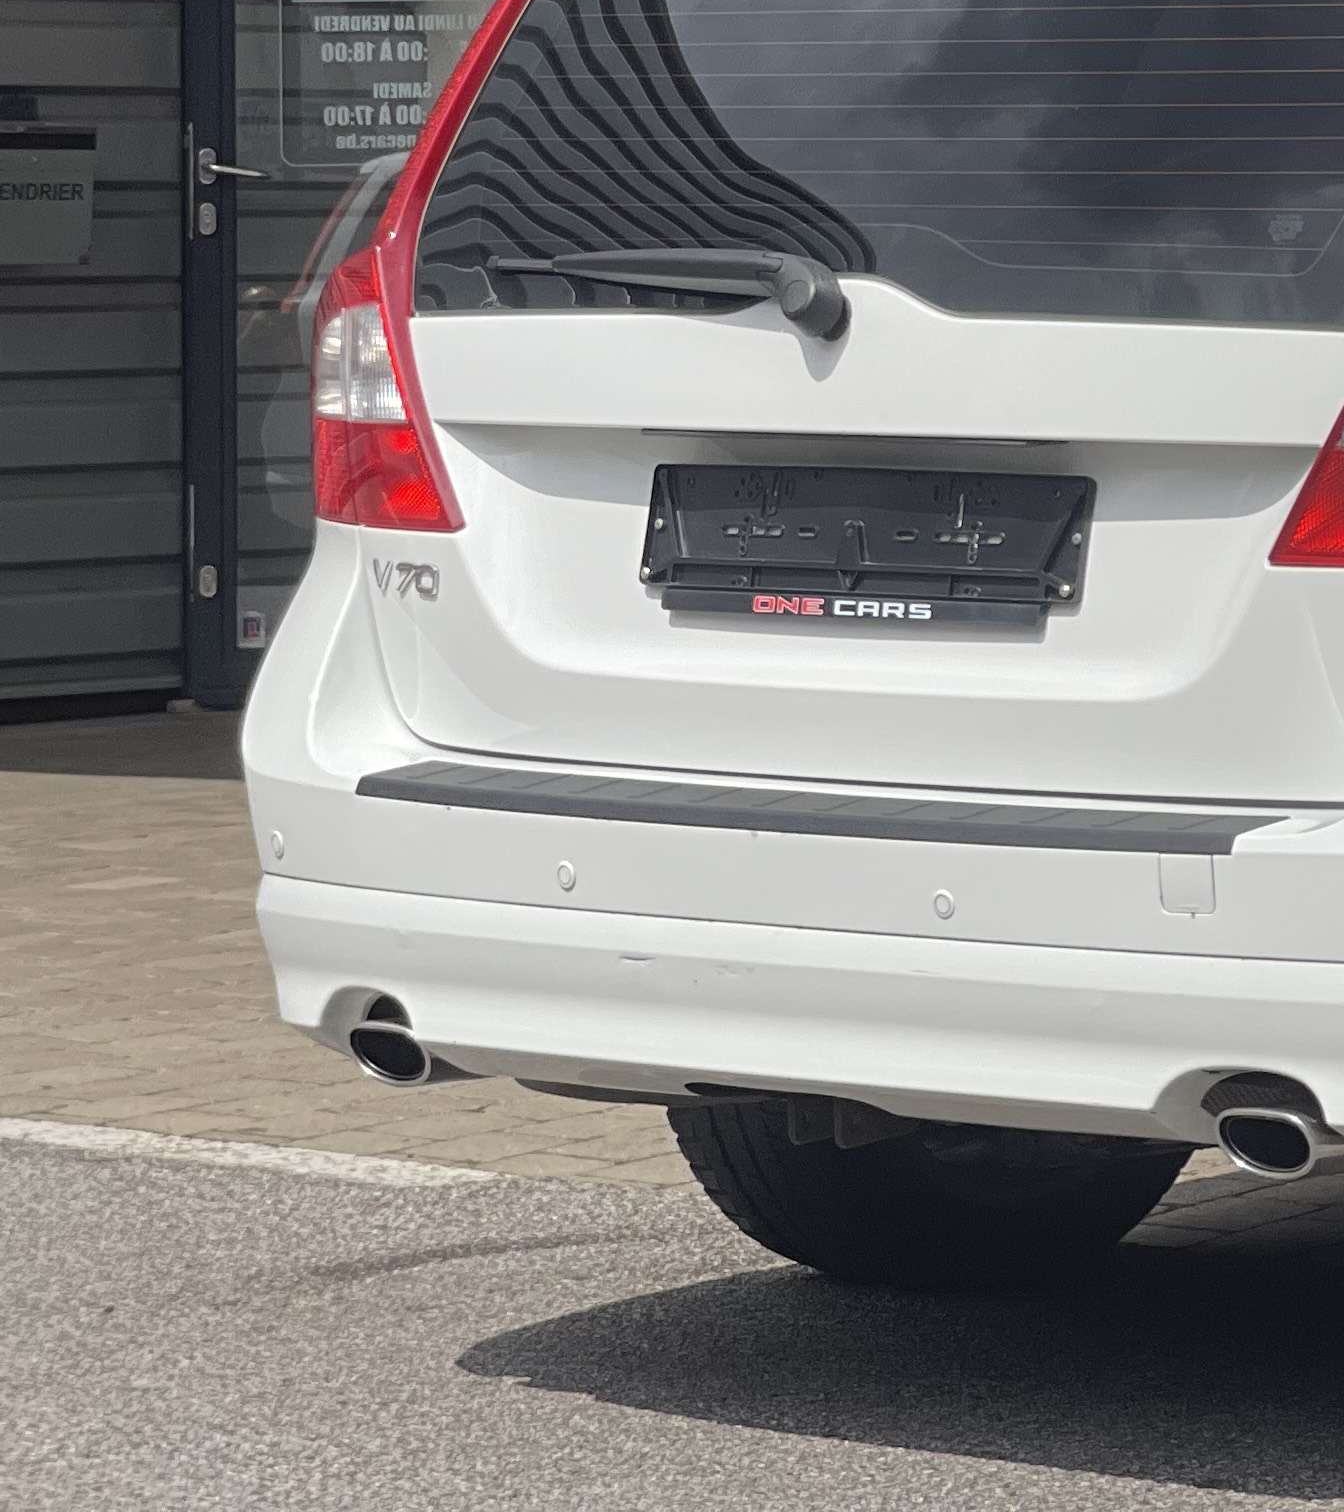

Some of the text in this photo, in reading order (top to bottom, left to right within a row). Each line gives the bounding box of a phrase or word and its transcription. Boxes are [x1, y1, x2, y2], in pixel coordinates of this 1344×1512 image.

[372, 558, 441, 600] V70
[752, 594, 933, 620] ONE CARS
